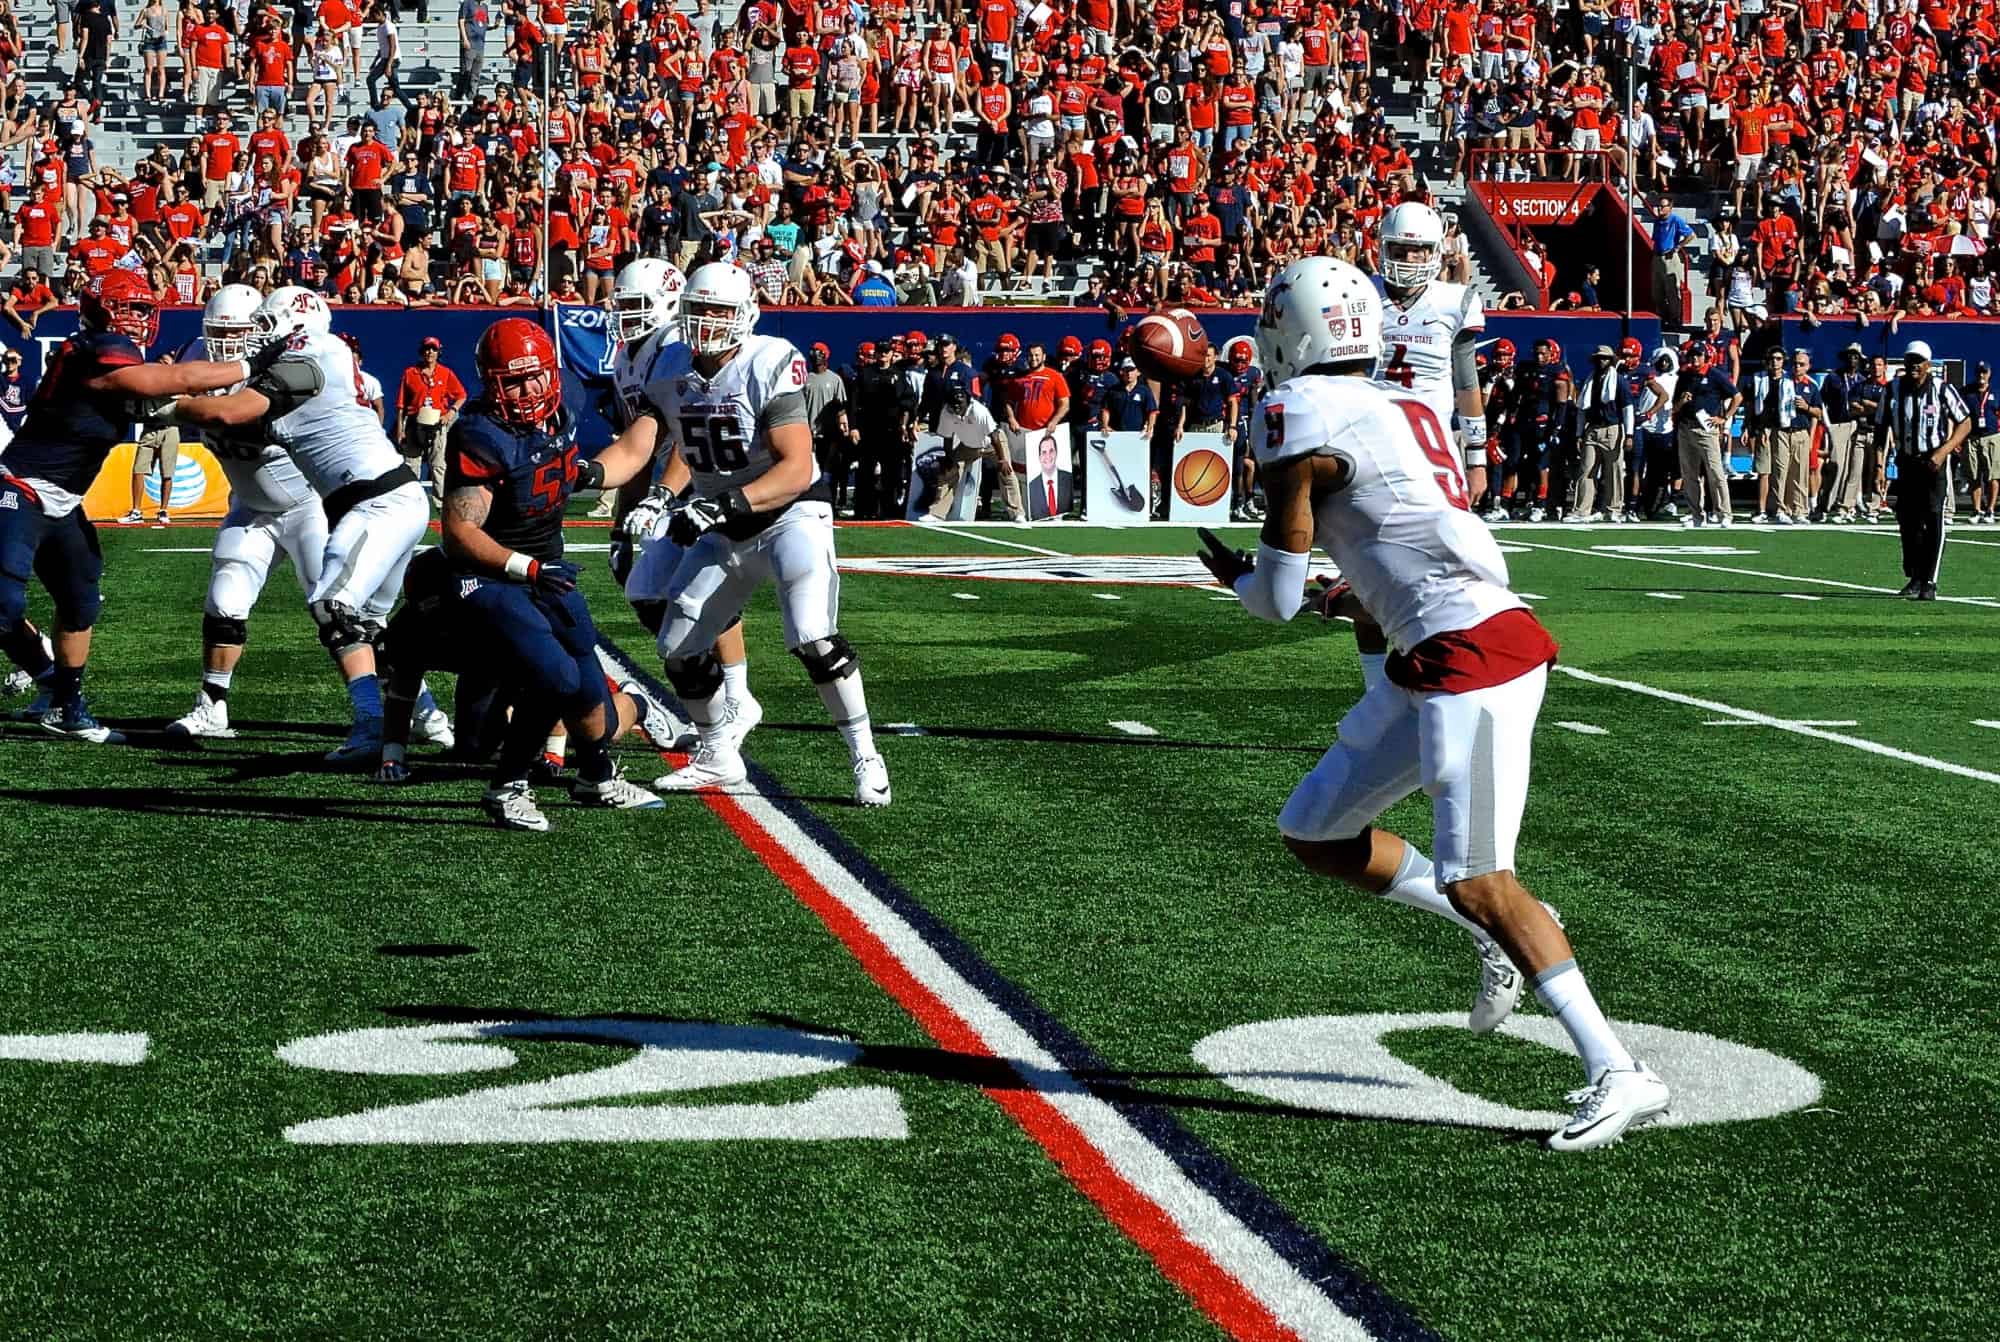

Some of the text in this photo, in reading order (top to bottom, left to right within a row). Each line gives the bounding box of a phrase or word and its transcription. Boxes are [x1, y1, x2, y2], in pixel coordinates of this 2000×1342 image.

[1499, 199, 1580, 217] 3 SECTION 4
[1351, 317, 1362, 338] 9
[1414, 334, 1433, 345] STATE
[1330, 344, 1369, 358] COUGARS
[1384, 343, 1416, 390] 4
[1265, 402, 1285, 449] 9
[680, 416, 749, 475] 56
[1387, 398, 1471, 513] 9
